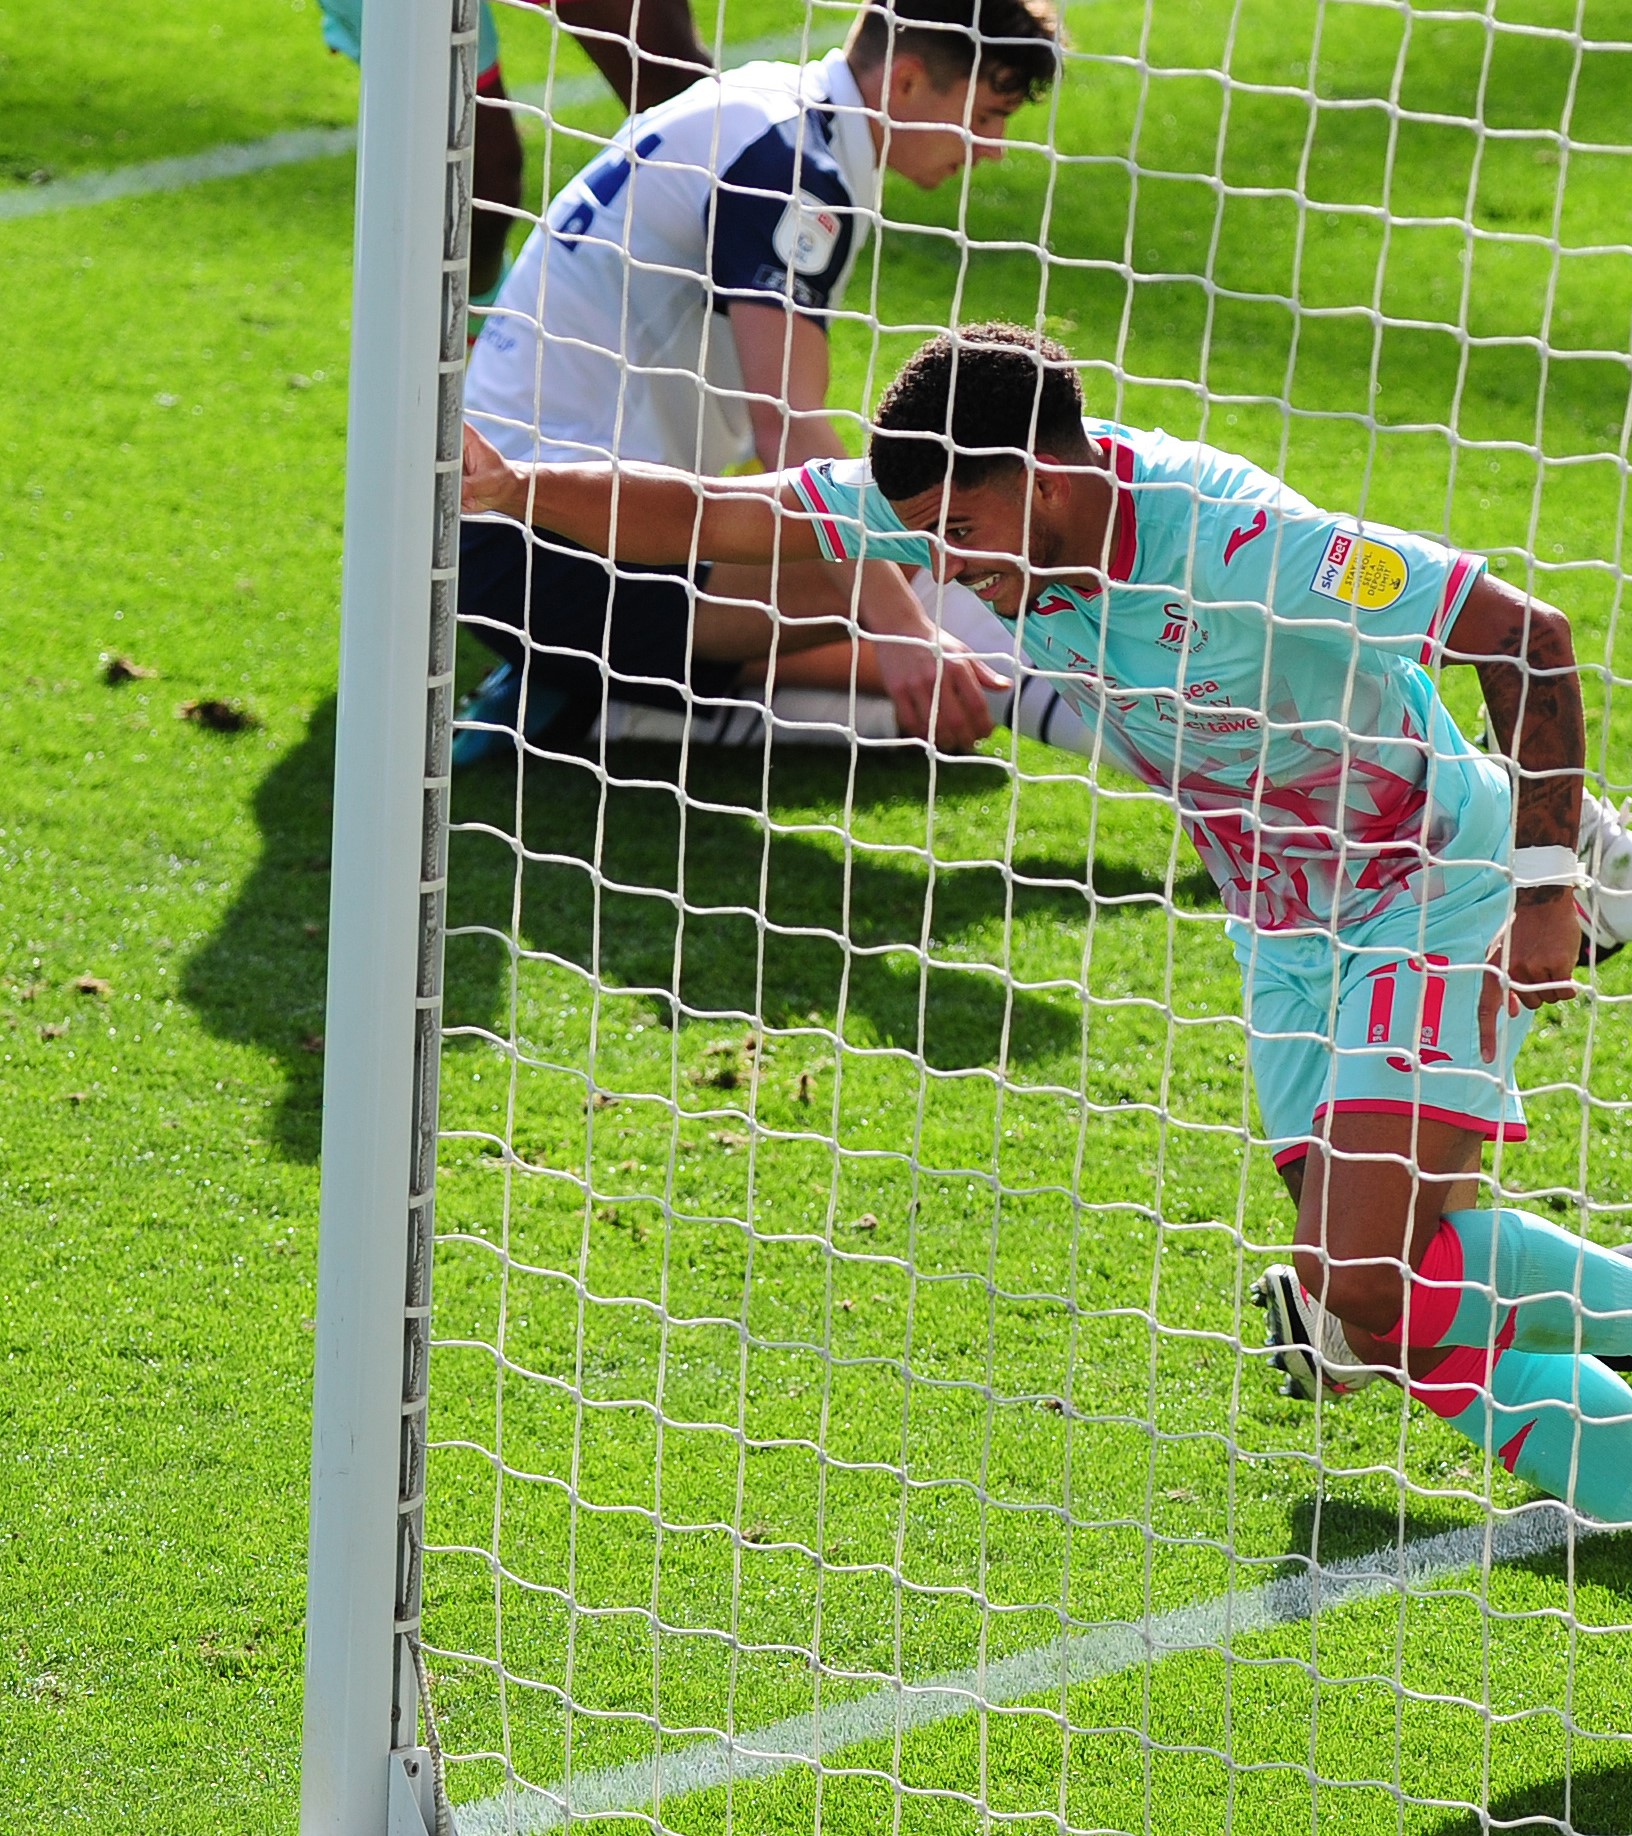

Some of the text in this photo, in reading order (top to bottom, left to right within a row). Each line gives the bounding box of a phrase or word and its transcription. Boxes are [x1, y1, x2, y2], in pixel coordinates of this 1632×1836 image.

[1321, 539, 1348, 589] sky bet
[1345, 565, 1355, 585] STAY
[1362, 571, 1372, 586] SET
[1367, 560, 1386, 596] DEPOSIT
[1378, 569, 1391, 592] LIMIT
[1366, 953, 1450, 1047] 11
